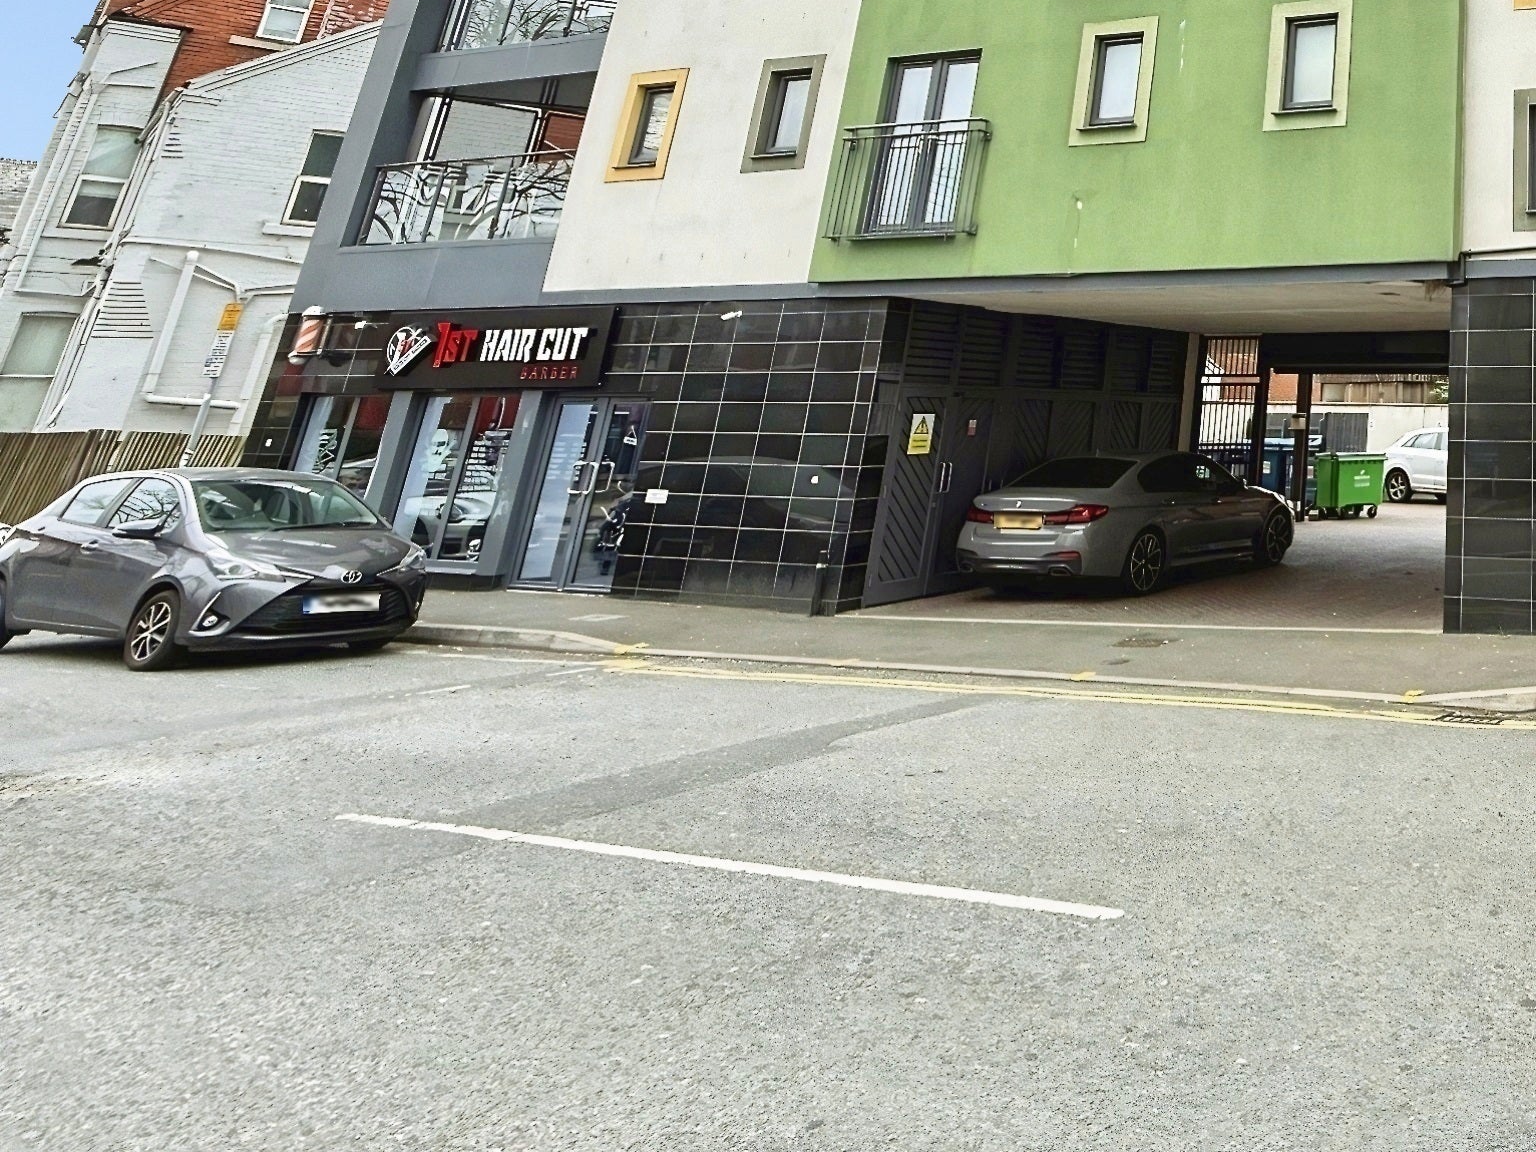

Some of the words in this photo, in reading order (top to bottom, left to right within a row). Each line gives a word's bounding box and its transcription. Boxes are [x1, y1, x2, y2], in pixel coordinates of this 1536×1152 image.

[432, 322, 478, 368] 1ST
[480, 328, 537, 363] HAIR
[536, 327, 588, 361] CUT
[519, 366, 577, 380] BARBER
